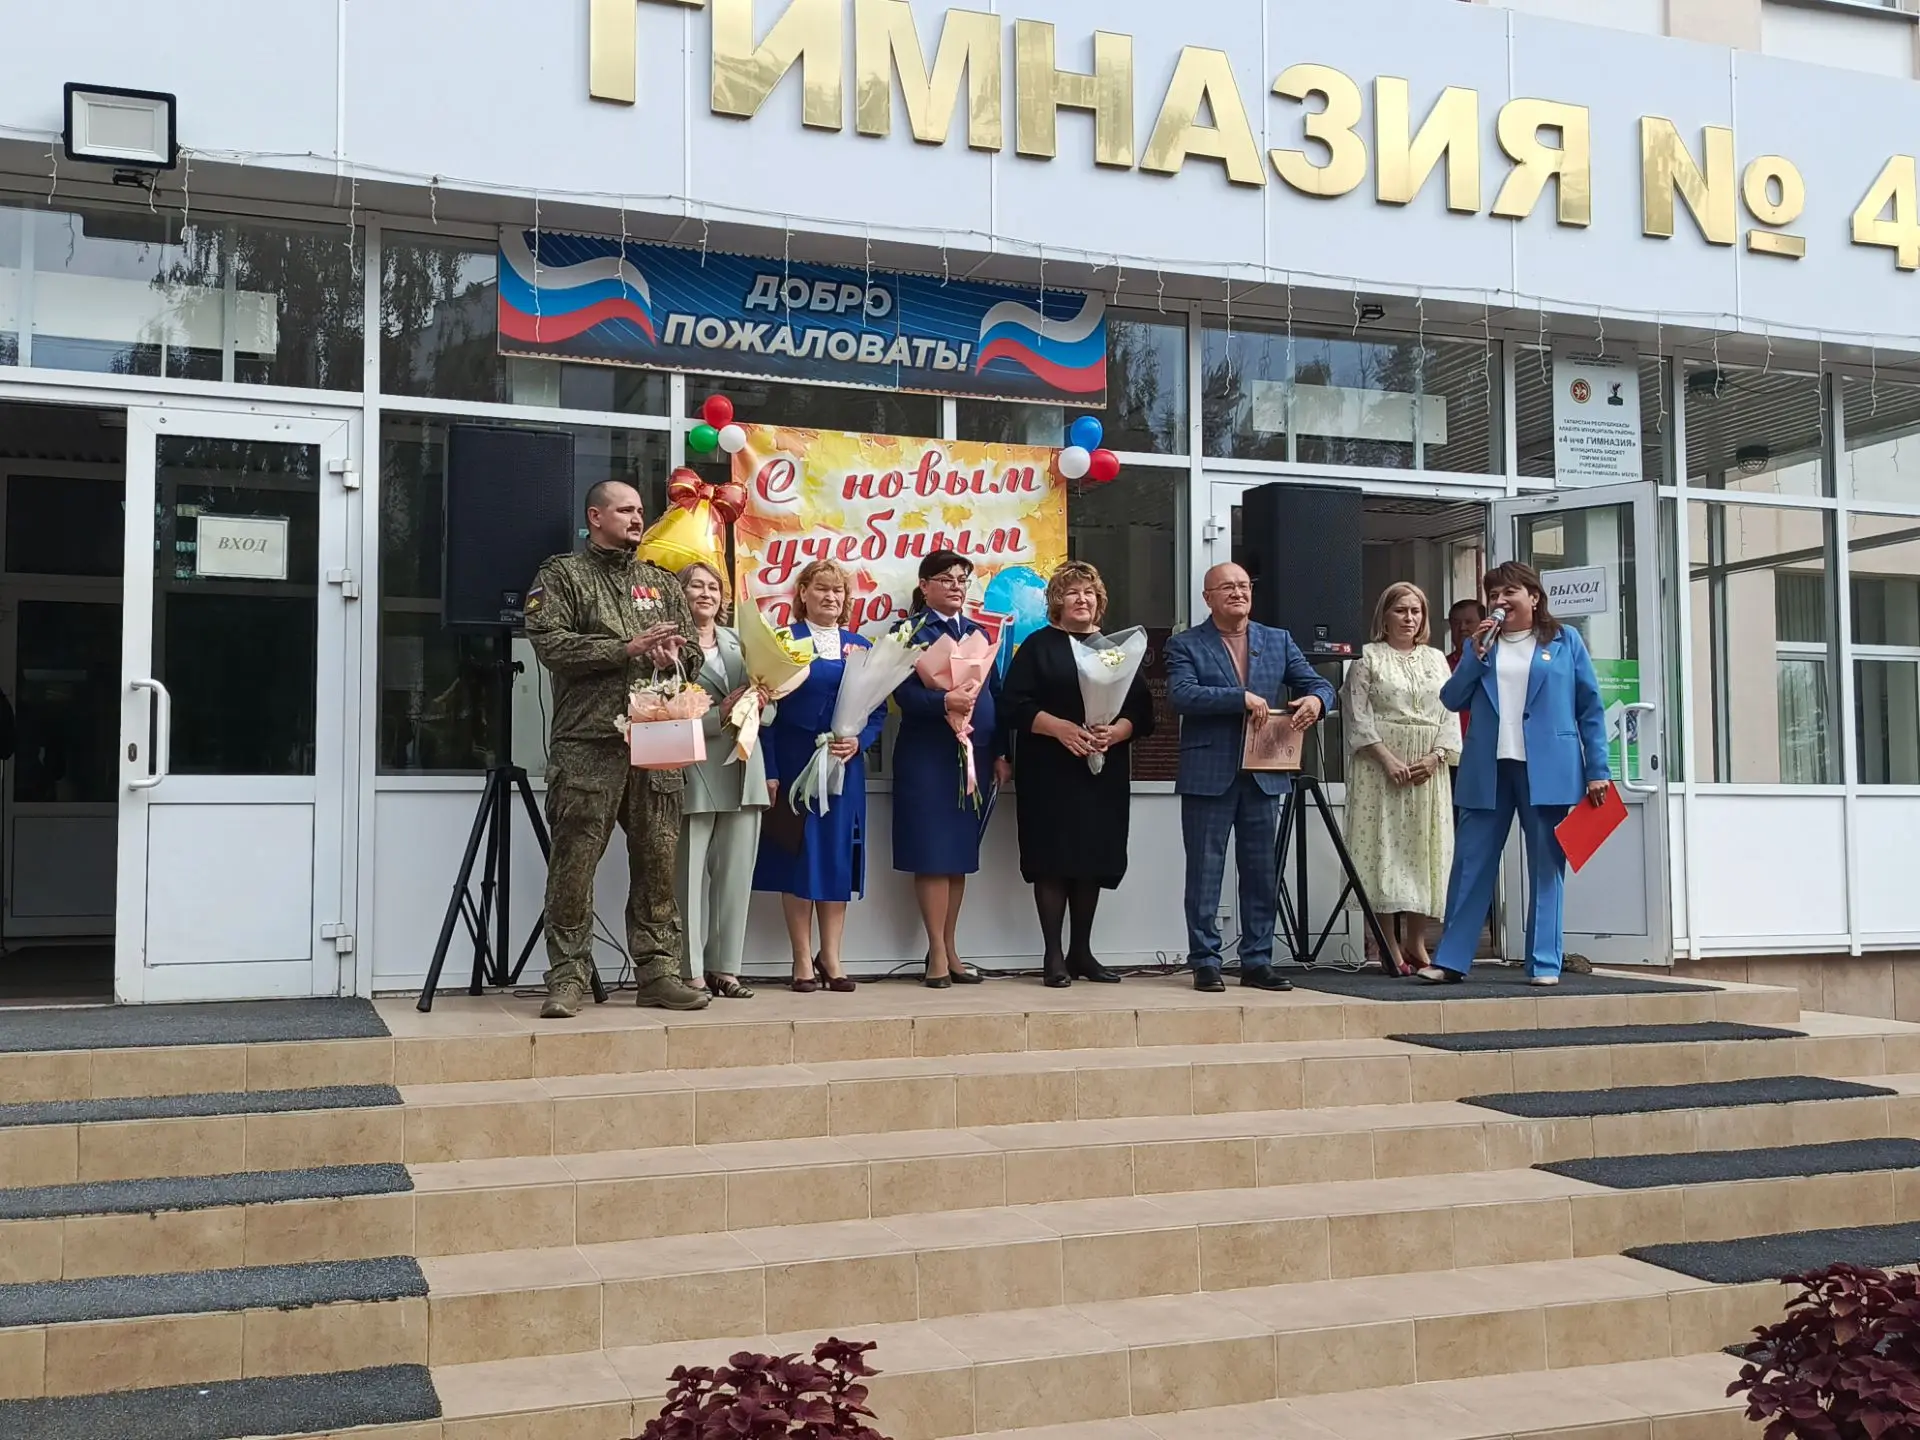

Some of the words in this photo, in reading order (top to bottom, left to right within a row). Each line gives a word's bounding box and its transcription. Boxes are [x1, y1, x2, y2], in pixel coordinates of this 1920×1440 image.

[589, 0, 1592, 230] ГИМНАЗИЯ
[1641, 115, 1806, 260] №
[1850, 153, 1920, 272] 4
[744, 274, 893, 318] ДОБРО
[663, 313, 971, 373] ПОЖАЛОВАТЬ!
[756, 458, 798, 503] С
[842, 450, 1041, 500] новым
[218, 536, 268, 554] ВХОД
[758, 508, 1027, 585] учебным
[1549, 580, 1600, 596] ВЫХОД
